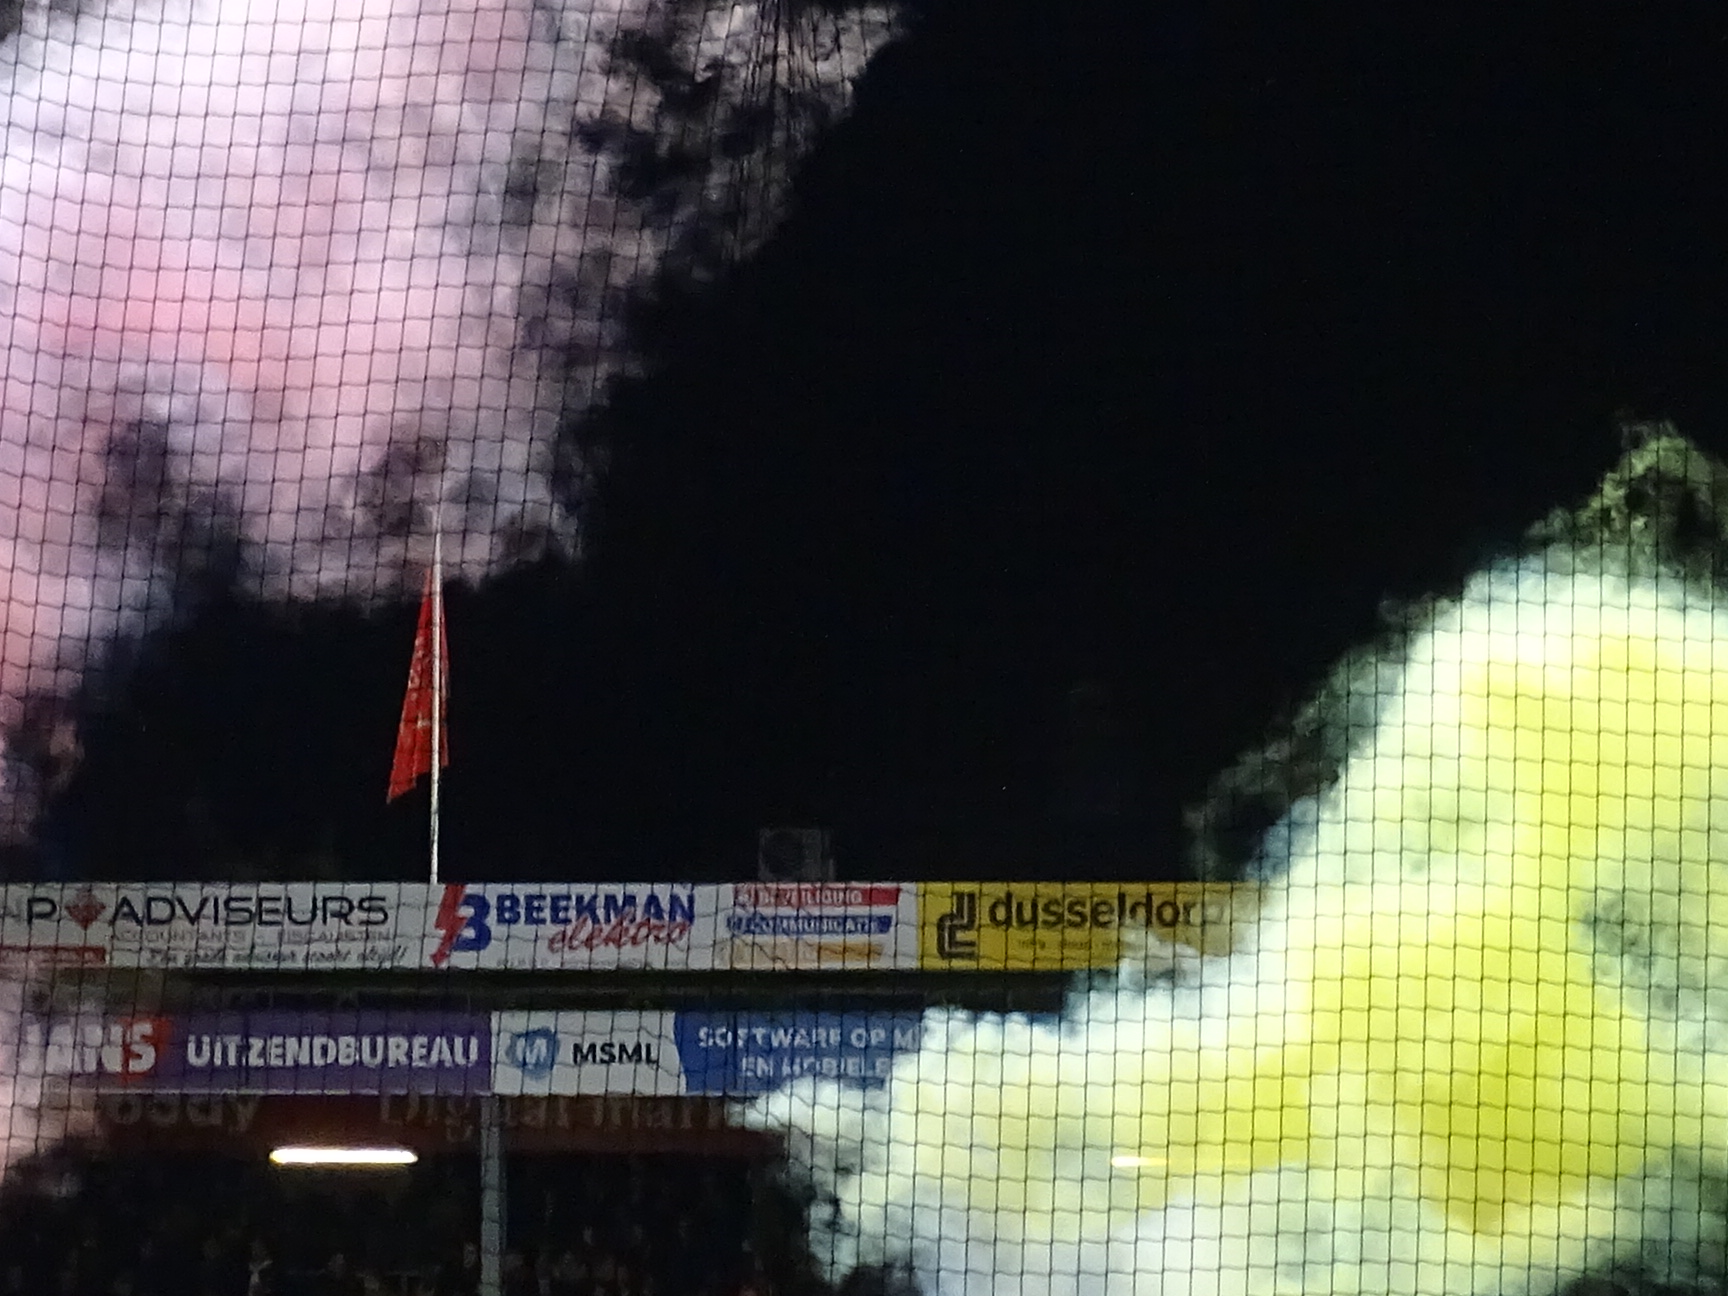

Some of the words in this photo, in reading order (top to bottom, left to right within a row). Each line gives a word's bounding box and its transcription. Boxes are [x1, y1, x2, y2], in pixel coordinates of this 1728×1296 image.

[112, 895, 389, 926] ADVISEURS
[496, 894, 693, 925] BEEKMAN
[186, 1035, 479, 1068] UITZENDBUREAU
[572, 1042, 660, 1065] MSML
